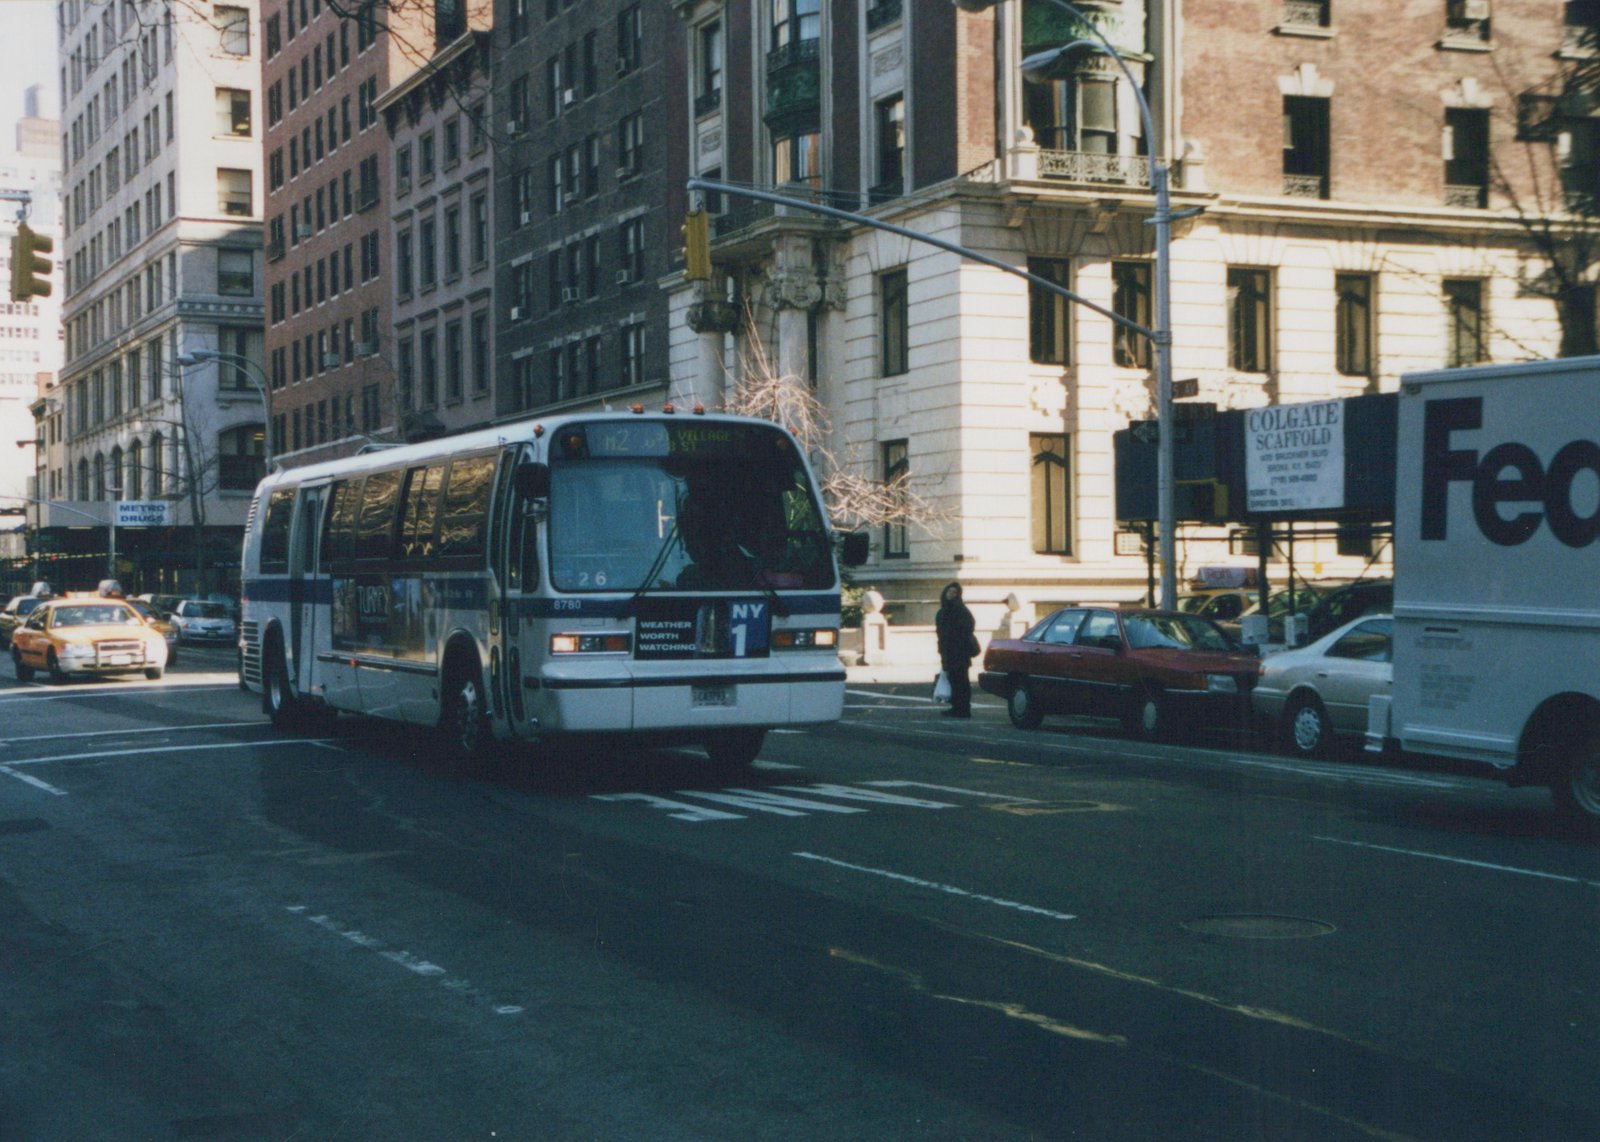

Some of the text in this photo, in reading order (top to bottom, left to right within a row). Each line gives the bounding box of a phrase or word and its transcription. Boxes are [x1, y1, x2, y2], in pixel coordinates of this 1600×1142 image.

[1249, 402, 1339, 433] COLGATE
[1256, 427, 1332, 451] SCAFFOLD
[119, 504, 166, 513] METRO
[120, 515, 165, 523] DRUGS
[553, 600, 582, 610] 8780
[732, 604, 764, 618] NY
[640, 621, 692, 629] WEATHER
[640, 632, 679, 640] WORTH
[731, 624, 747, 657] 1
[639, 643, 697, 651] WATCHING
